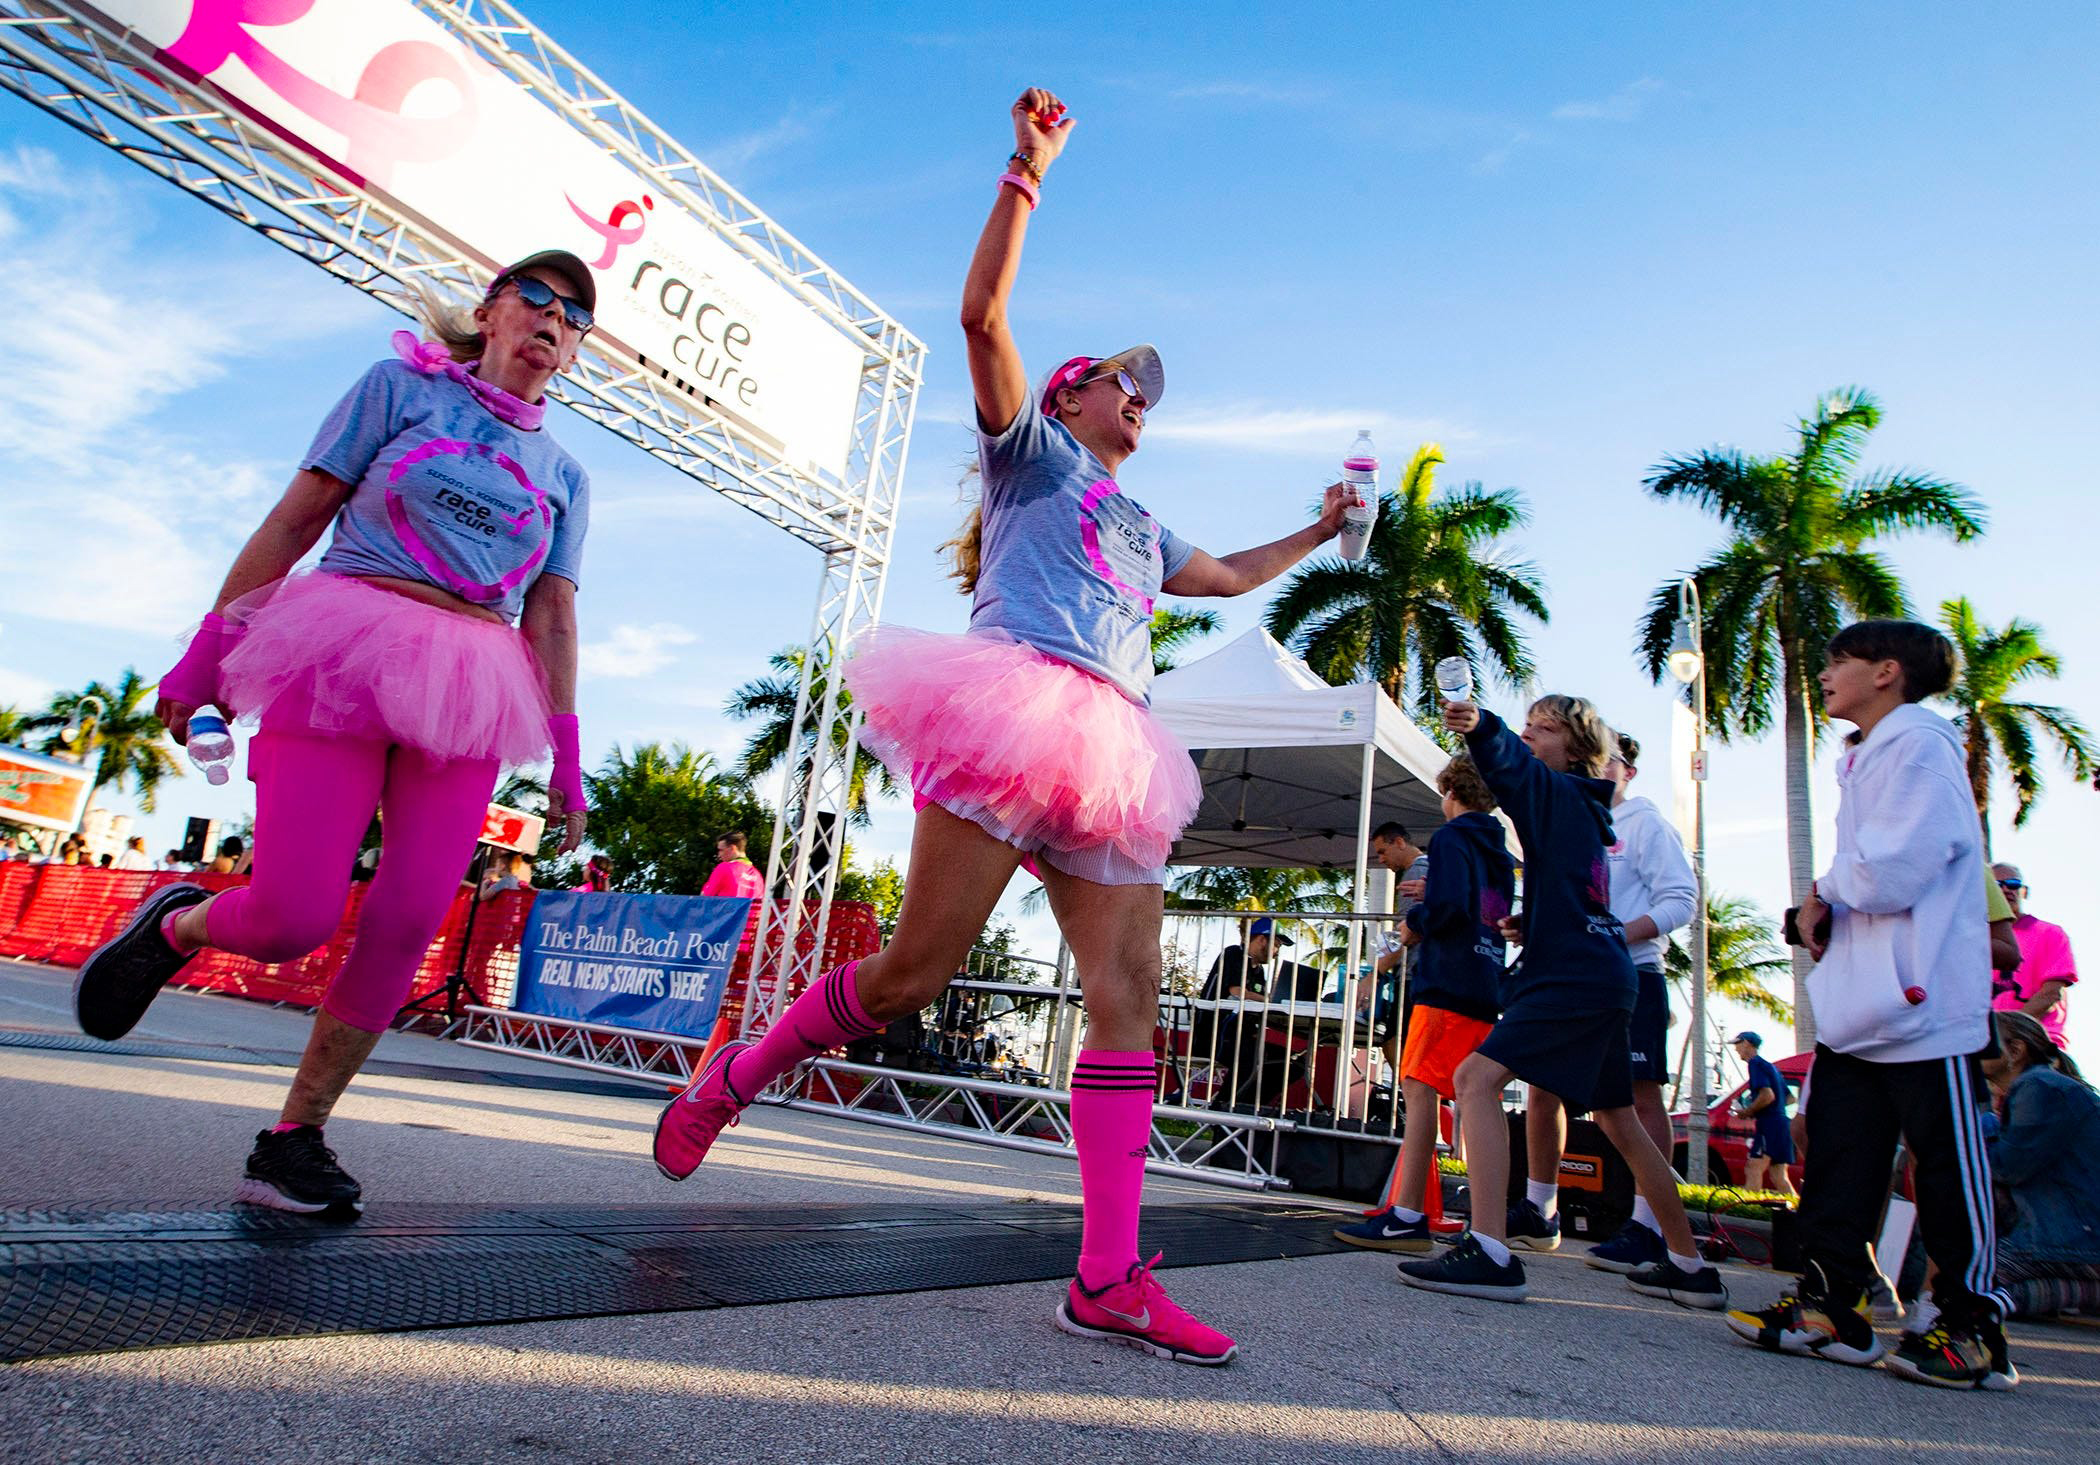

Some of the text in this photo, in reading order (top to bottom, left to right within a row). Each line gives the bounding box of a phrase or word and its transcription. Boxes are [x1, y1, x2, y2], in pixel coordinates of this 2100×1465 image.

[630, 260, 752, 363] race
[672, 333, 758, 407] cure
[425, 468, 465, 489] susan
[435, 488, 491, 520] race
[1117, 522, 1146, 548] race
[540, 922, 731, 962] The Palm Beach Post
[539, 958, 710, 1002] REAL NEWS STARTS HERE
